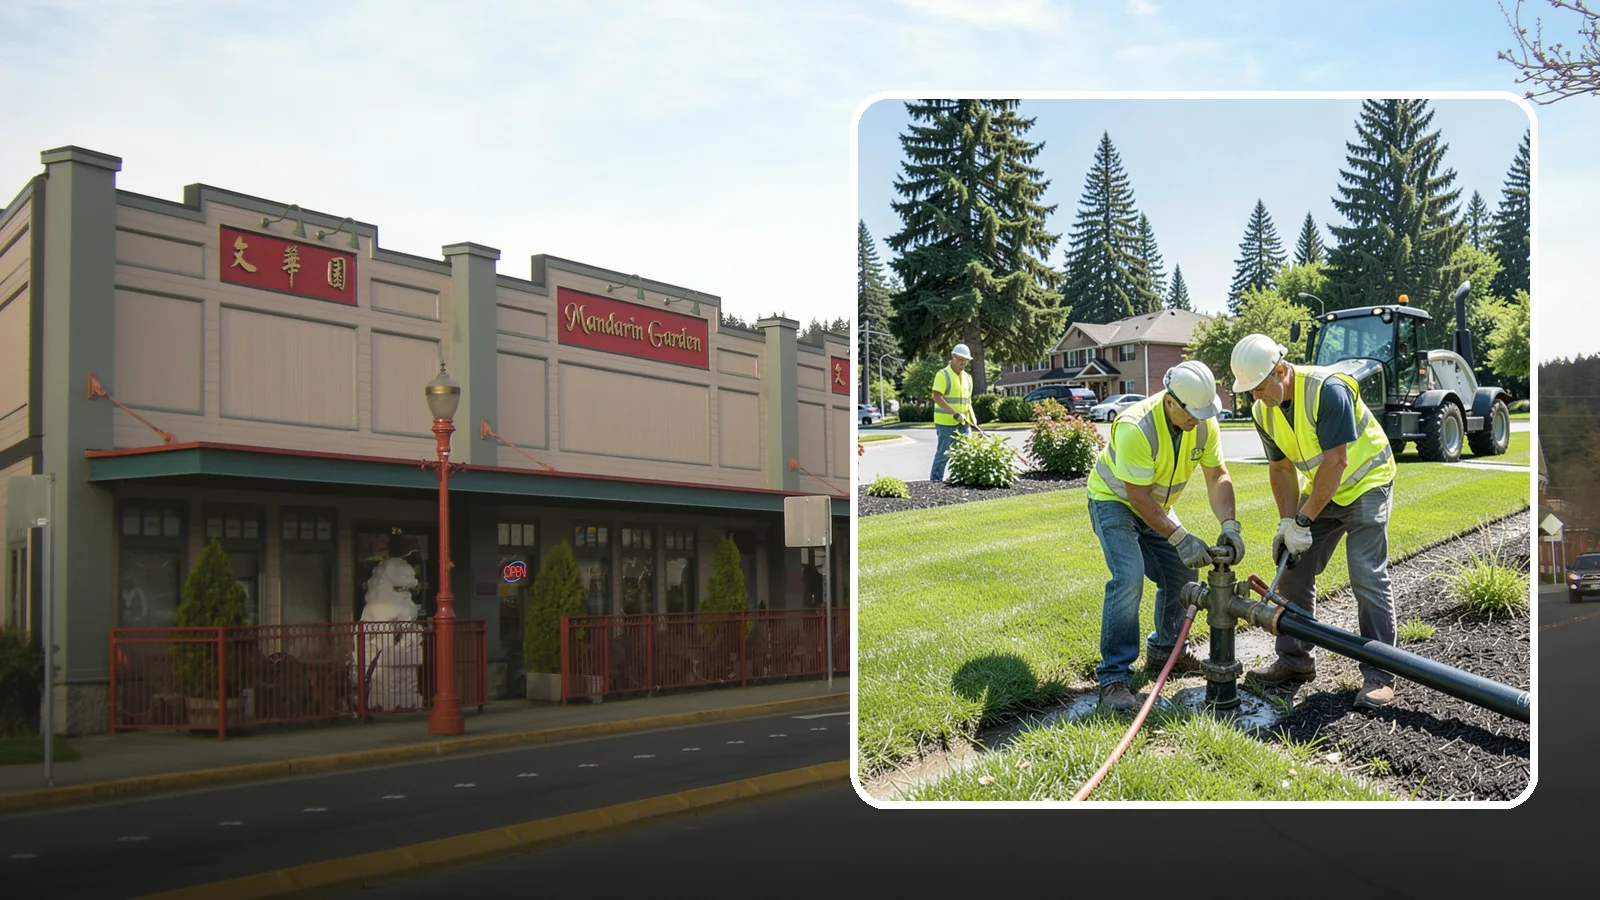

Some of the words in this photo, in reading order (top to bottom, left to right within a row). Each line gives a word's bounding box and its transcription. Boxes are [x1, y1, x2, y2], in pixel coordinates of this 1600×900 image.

[230, 235, 347, 291] 文華園
[564, 302, 644, 341] Mandarin
[648, 320, 701, 352] Garden
[503, 565, 527, 578] OPEN
